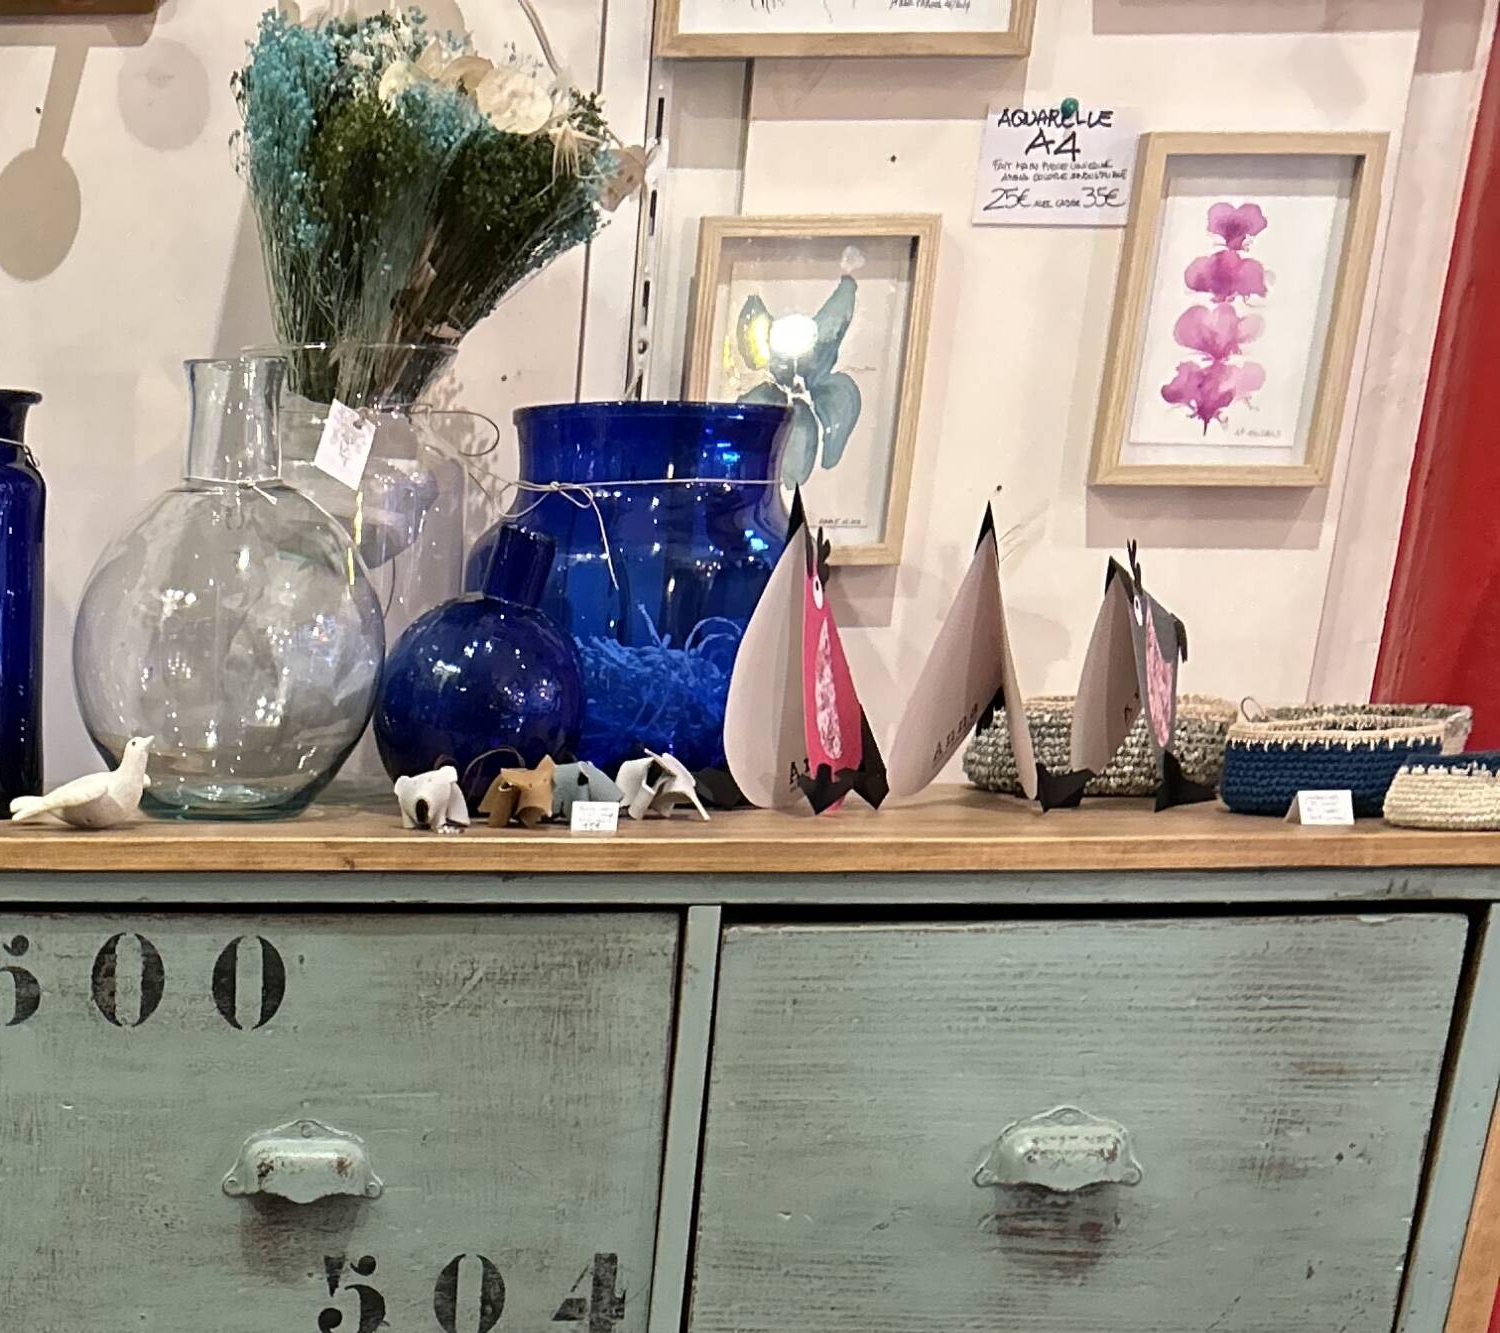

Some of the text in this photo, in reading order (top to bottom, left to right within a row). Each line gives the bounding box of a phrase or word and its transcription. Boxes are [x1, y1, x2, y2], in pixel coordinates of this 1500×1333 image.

[998, 108, 1113, 128] AQUARELLE
[1025, 128, 1080, 161] A4
[983, 186, 1031, 211] 25€
[1081, 186, 1126, 208] 35€
